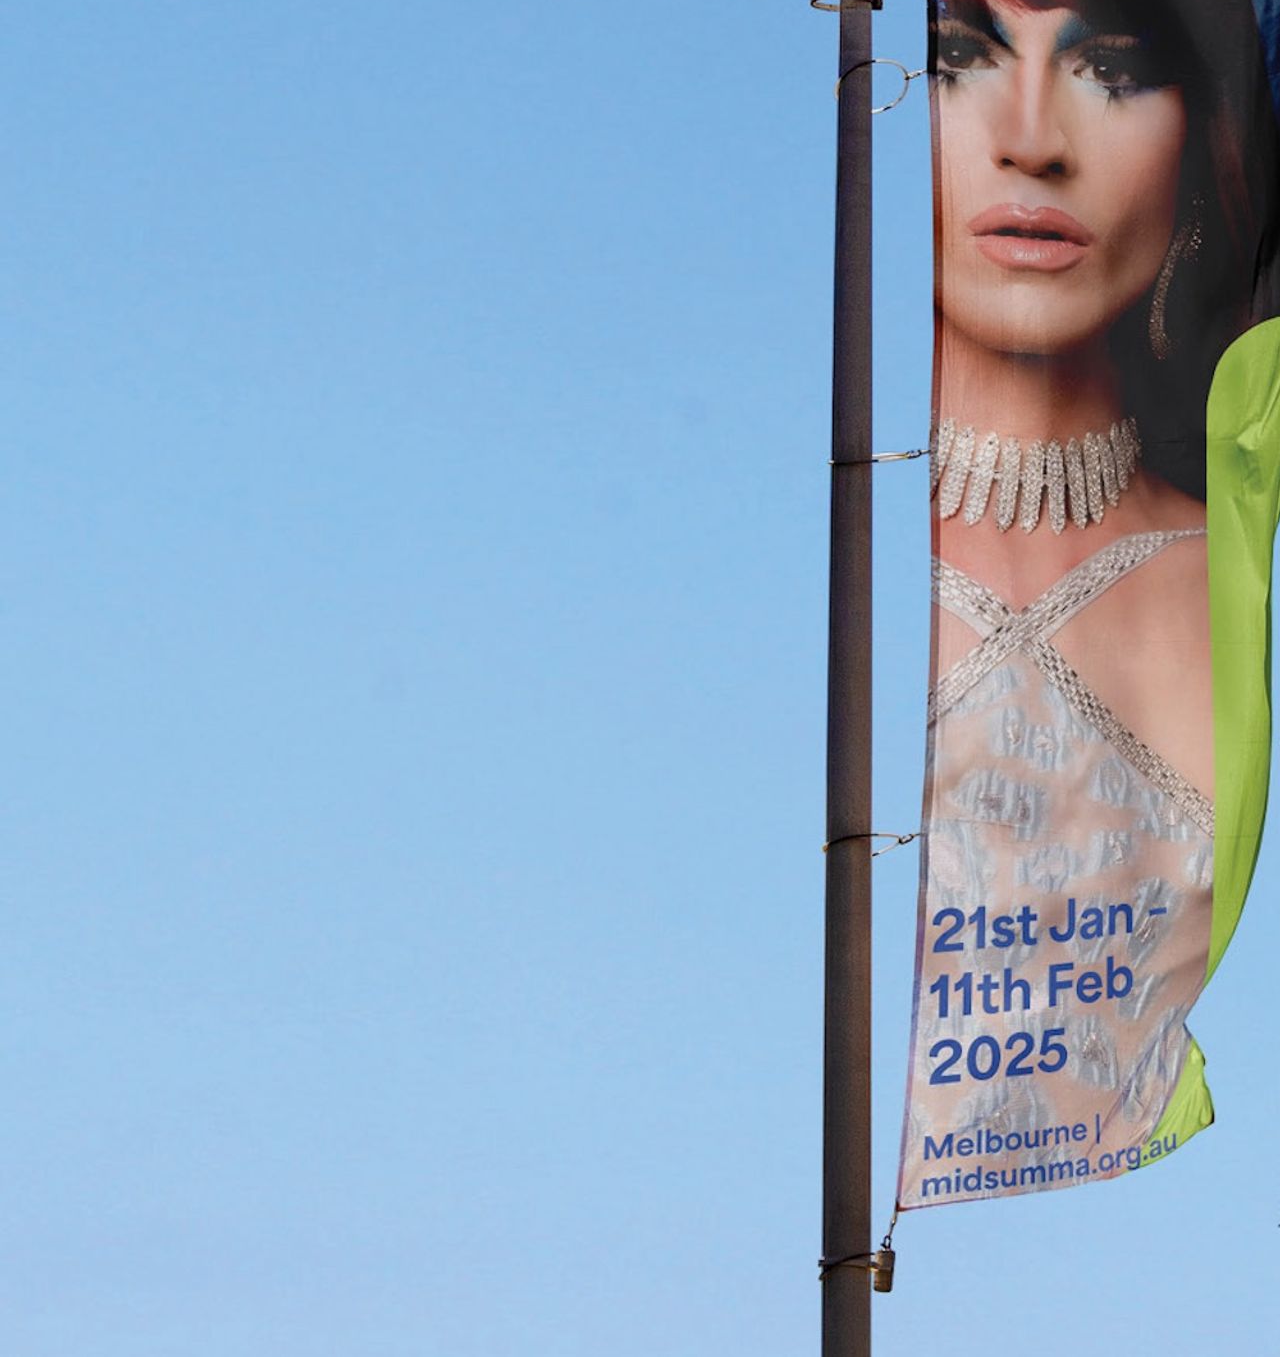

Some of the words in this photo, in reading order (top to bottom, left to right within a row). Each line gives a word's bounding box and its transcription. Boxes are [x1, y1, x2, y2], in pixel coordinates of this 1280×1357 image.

[932, 904, 1037, 953] 21st
[1049, 897, 1133, 942] Jan
[929, 968, 1031, 1019] 11th
[1048, 956, 1133, 1009] Feb
[929, 1027, 1068, 1085] 2025
[921, 1133, 1178, 1197] midsumma.org.au
[923, 1120, 1088, 1160] Melbourne
